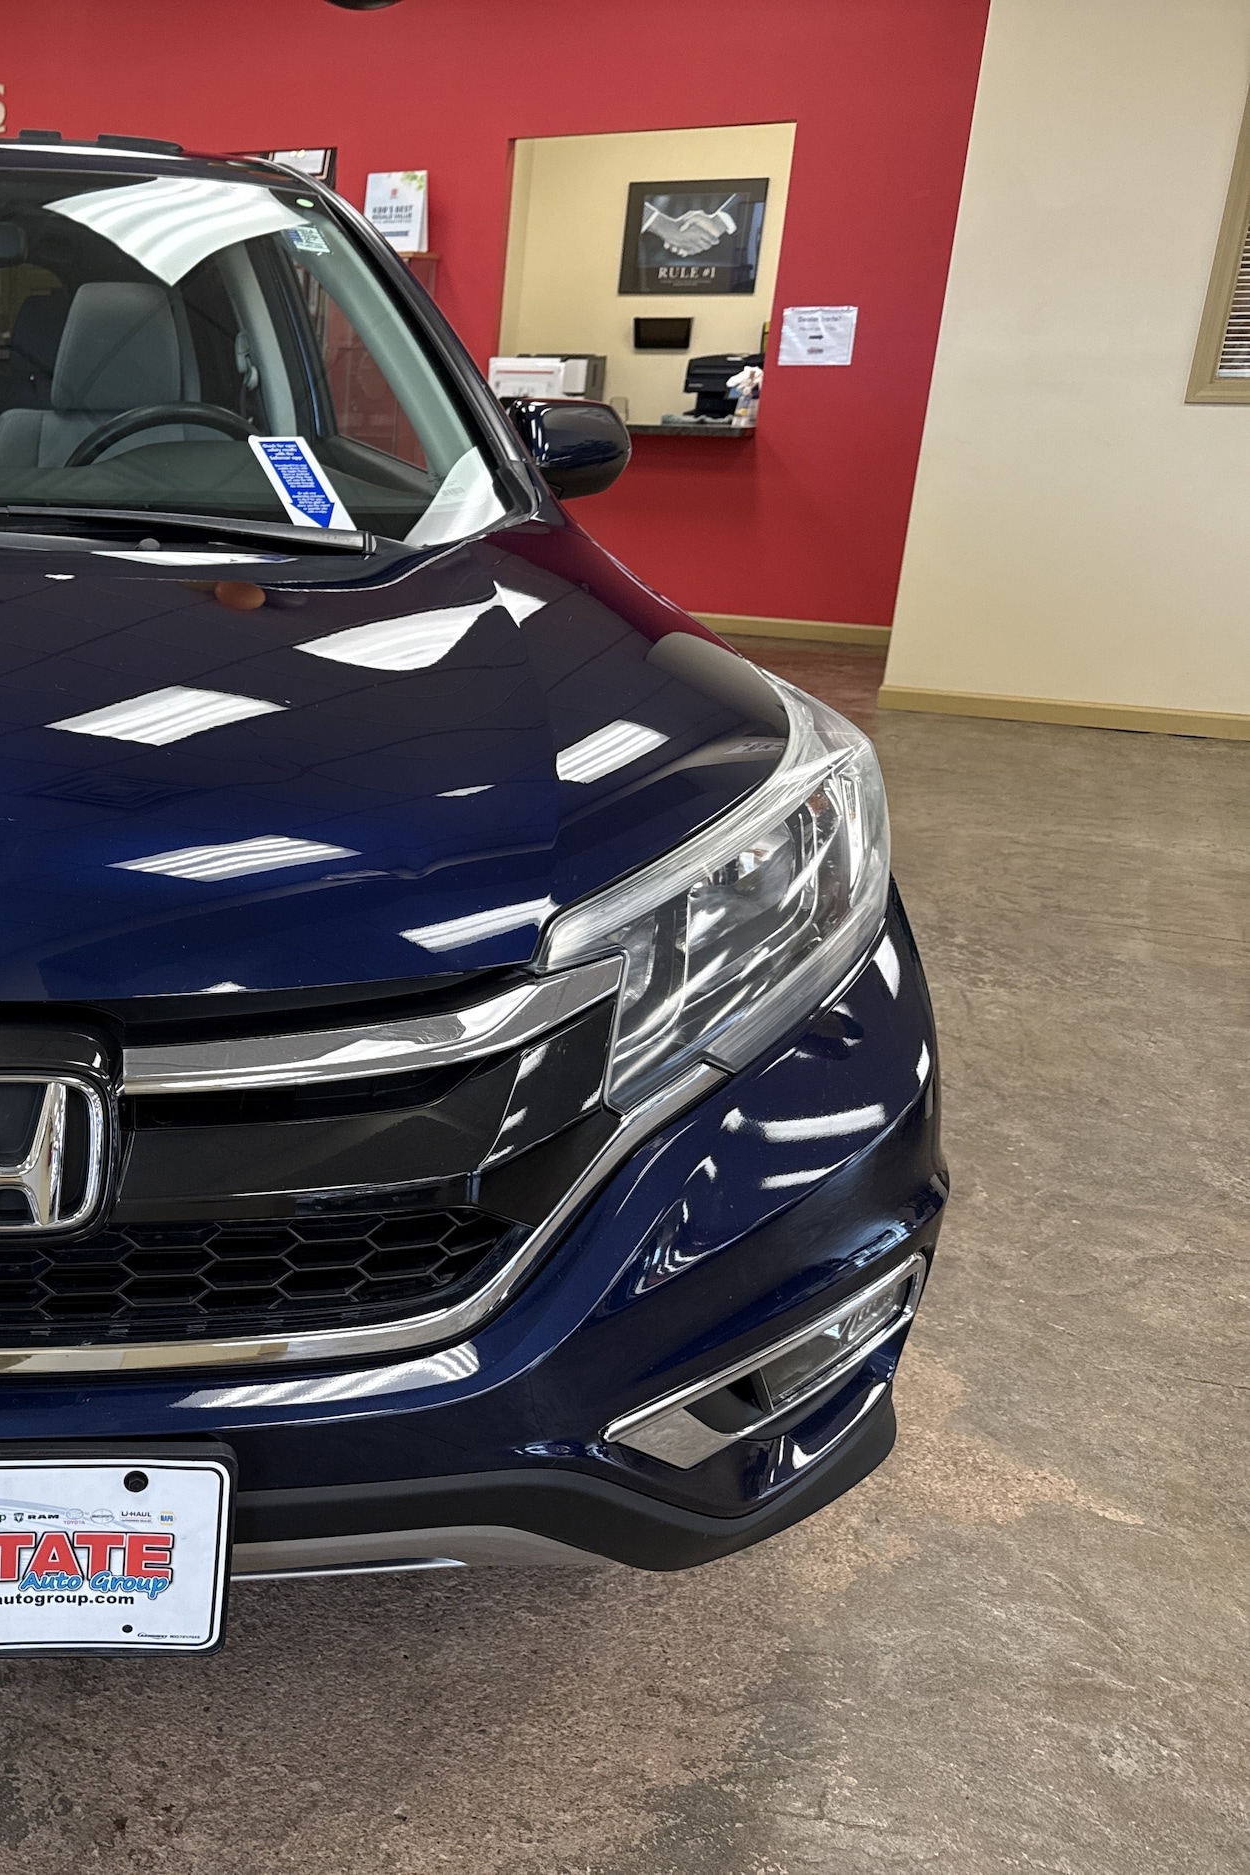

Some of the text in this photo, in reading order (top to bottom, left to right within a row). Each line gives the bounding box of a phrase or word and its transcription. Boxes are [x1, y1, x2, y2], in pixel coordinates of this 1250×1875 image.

[657, 266, 716, 279] RULE #1
[19, 1571, 170, 1598] Auto Group
